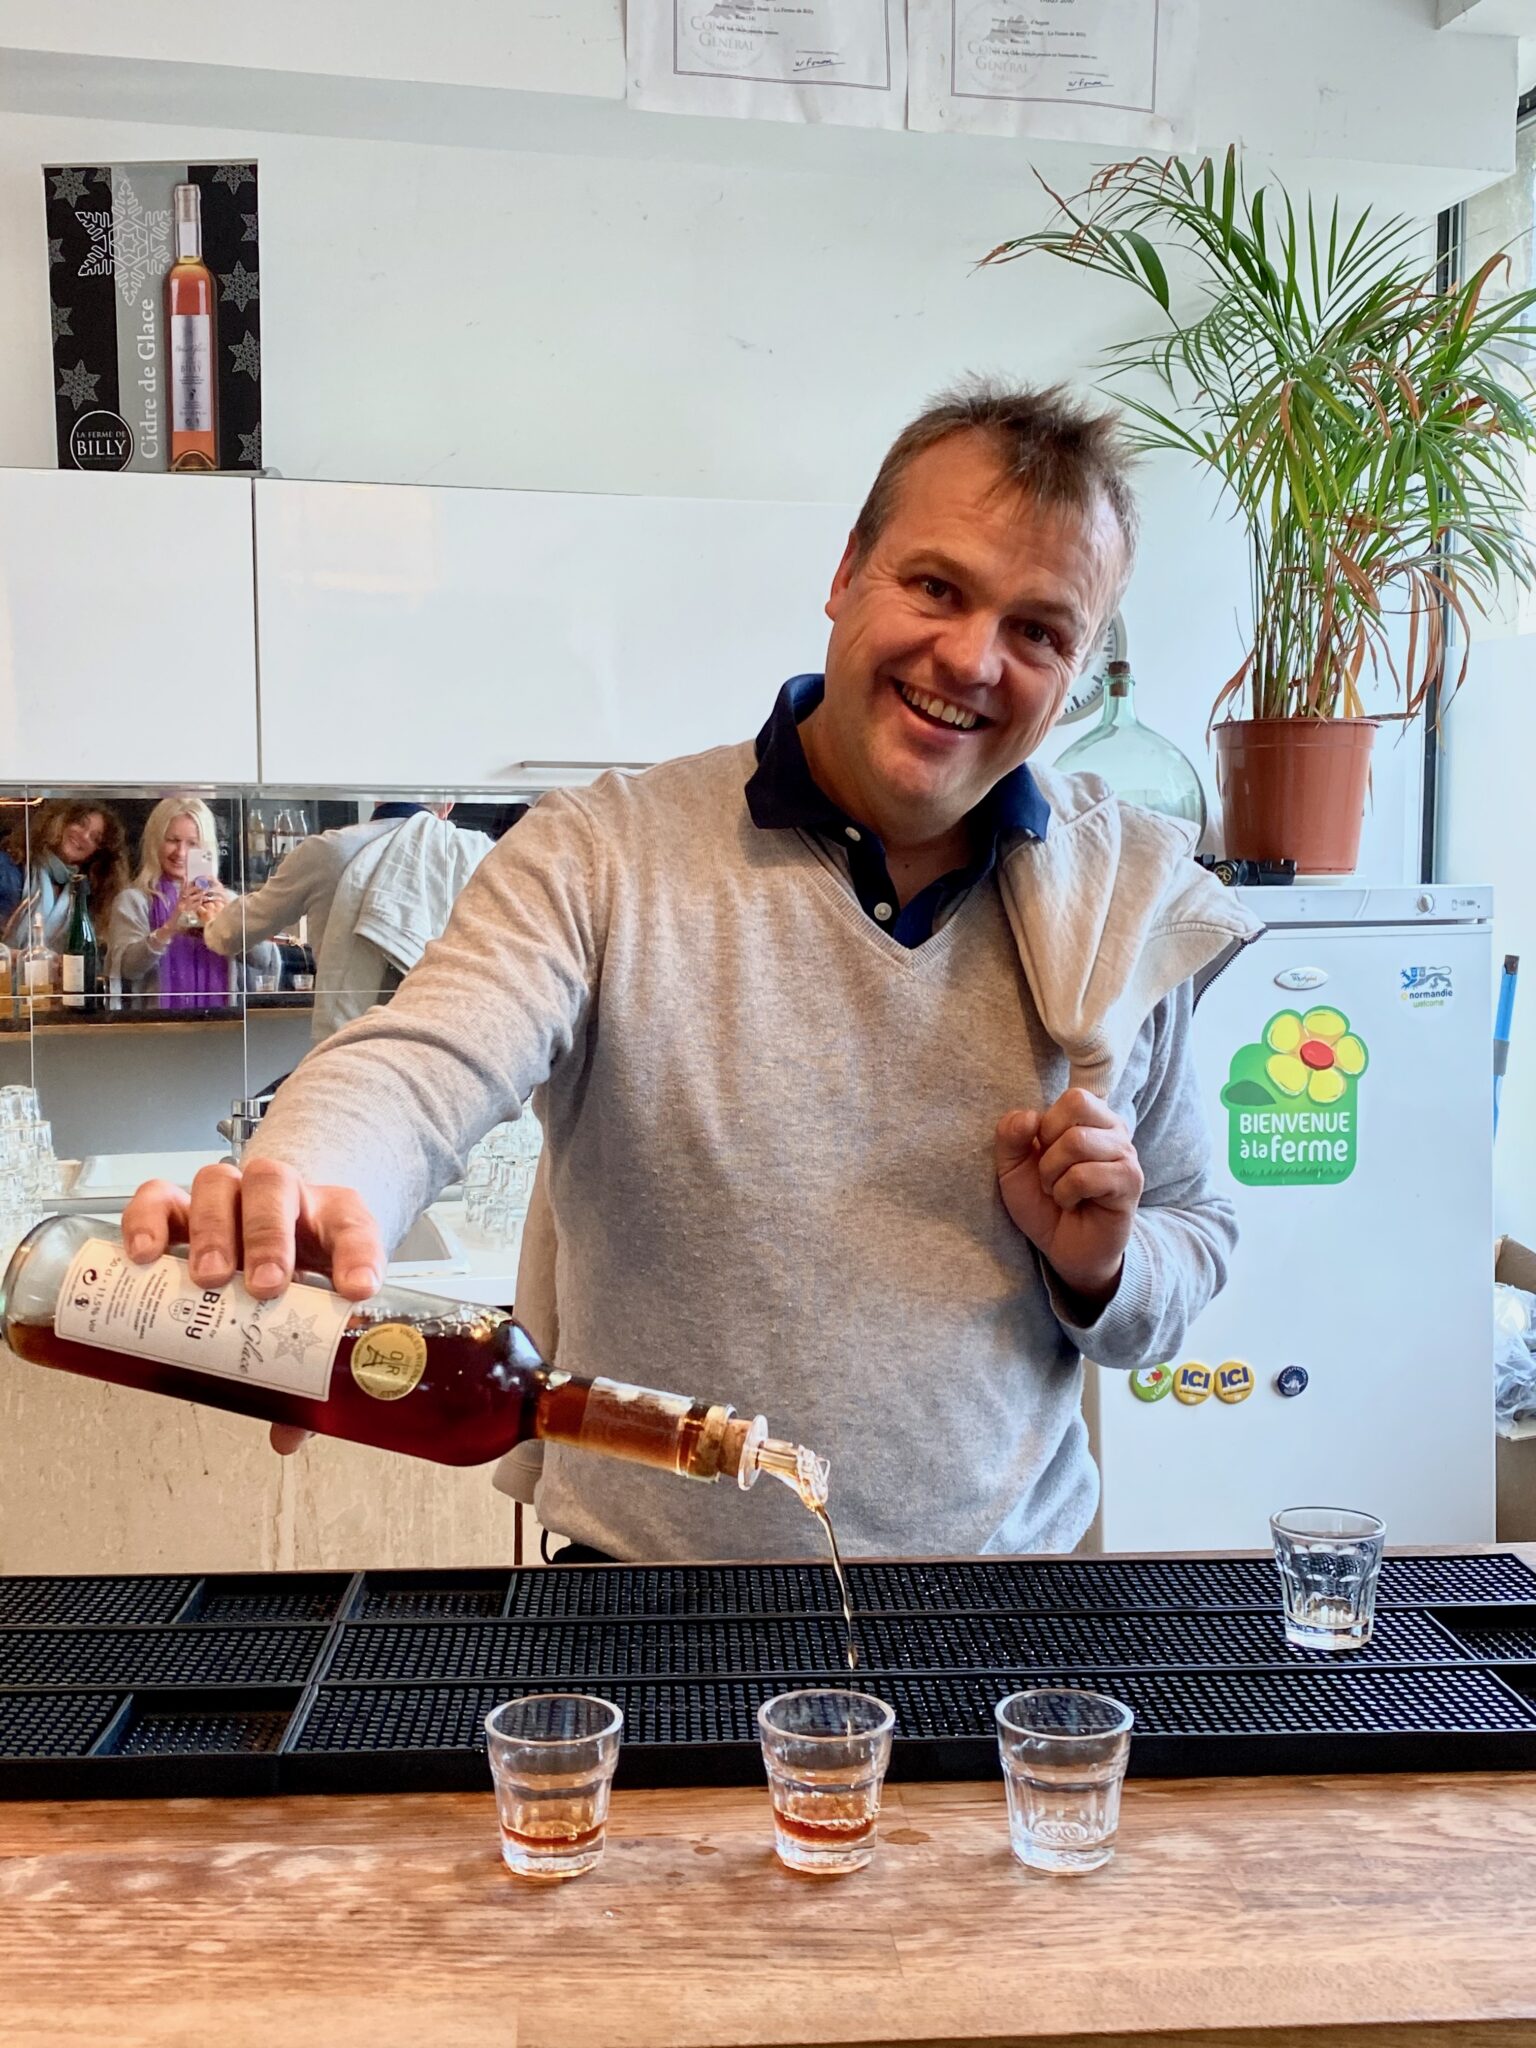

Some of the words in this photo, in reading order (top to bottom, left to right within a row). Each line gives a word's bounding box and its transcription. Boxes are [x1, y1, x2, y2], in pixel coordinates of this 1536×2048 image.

[136, 298, 156, 361] Glace
[138, 366, 157, 393] de
[115, 430, 127, 438] DE
[139, 398, 159, 459] Cidre
[77, 439, 127, 456] BILLY
[1409, 989, 1453, 999] normandie
[1413, 1000, 1444, 1008] welcome
[1240, 1112, 1350, 1134] BIENVENUE
[1240, 1139, 1250, 1159] à
[1252, 1140, 1268, 1159] la
[1271, 1134, 1349, 1163] ferme
[185, 1291, 221, 1340] Billy
[1181, 1369, 1211, 1390] ICI
[1220, 1366, 1250, 1389] ICI
